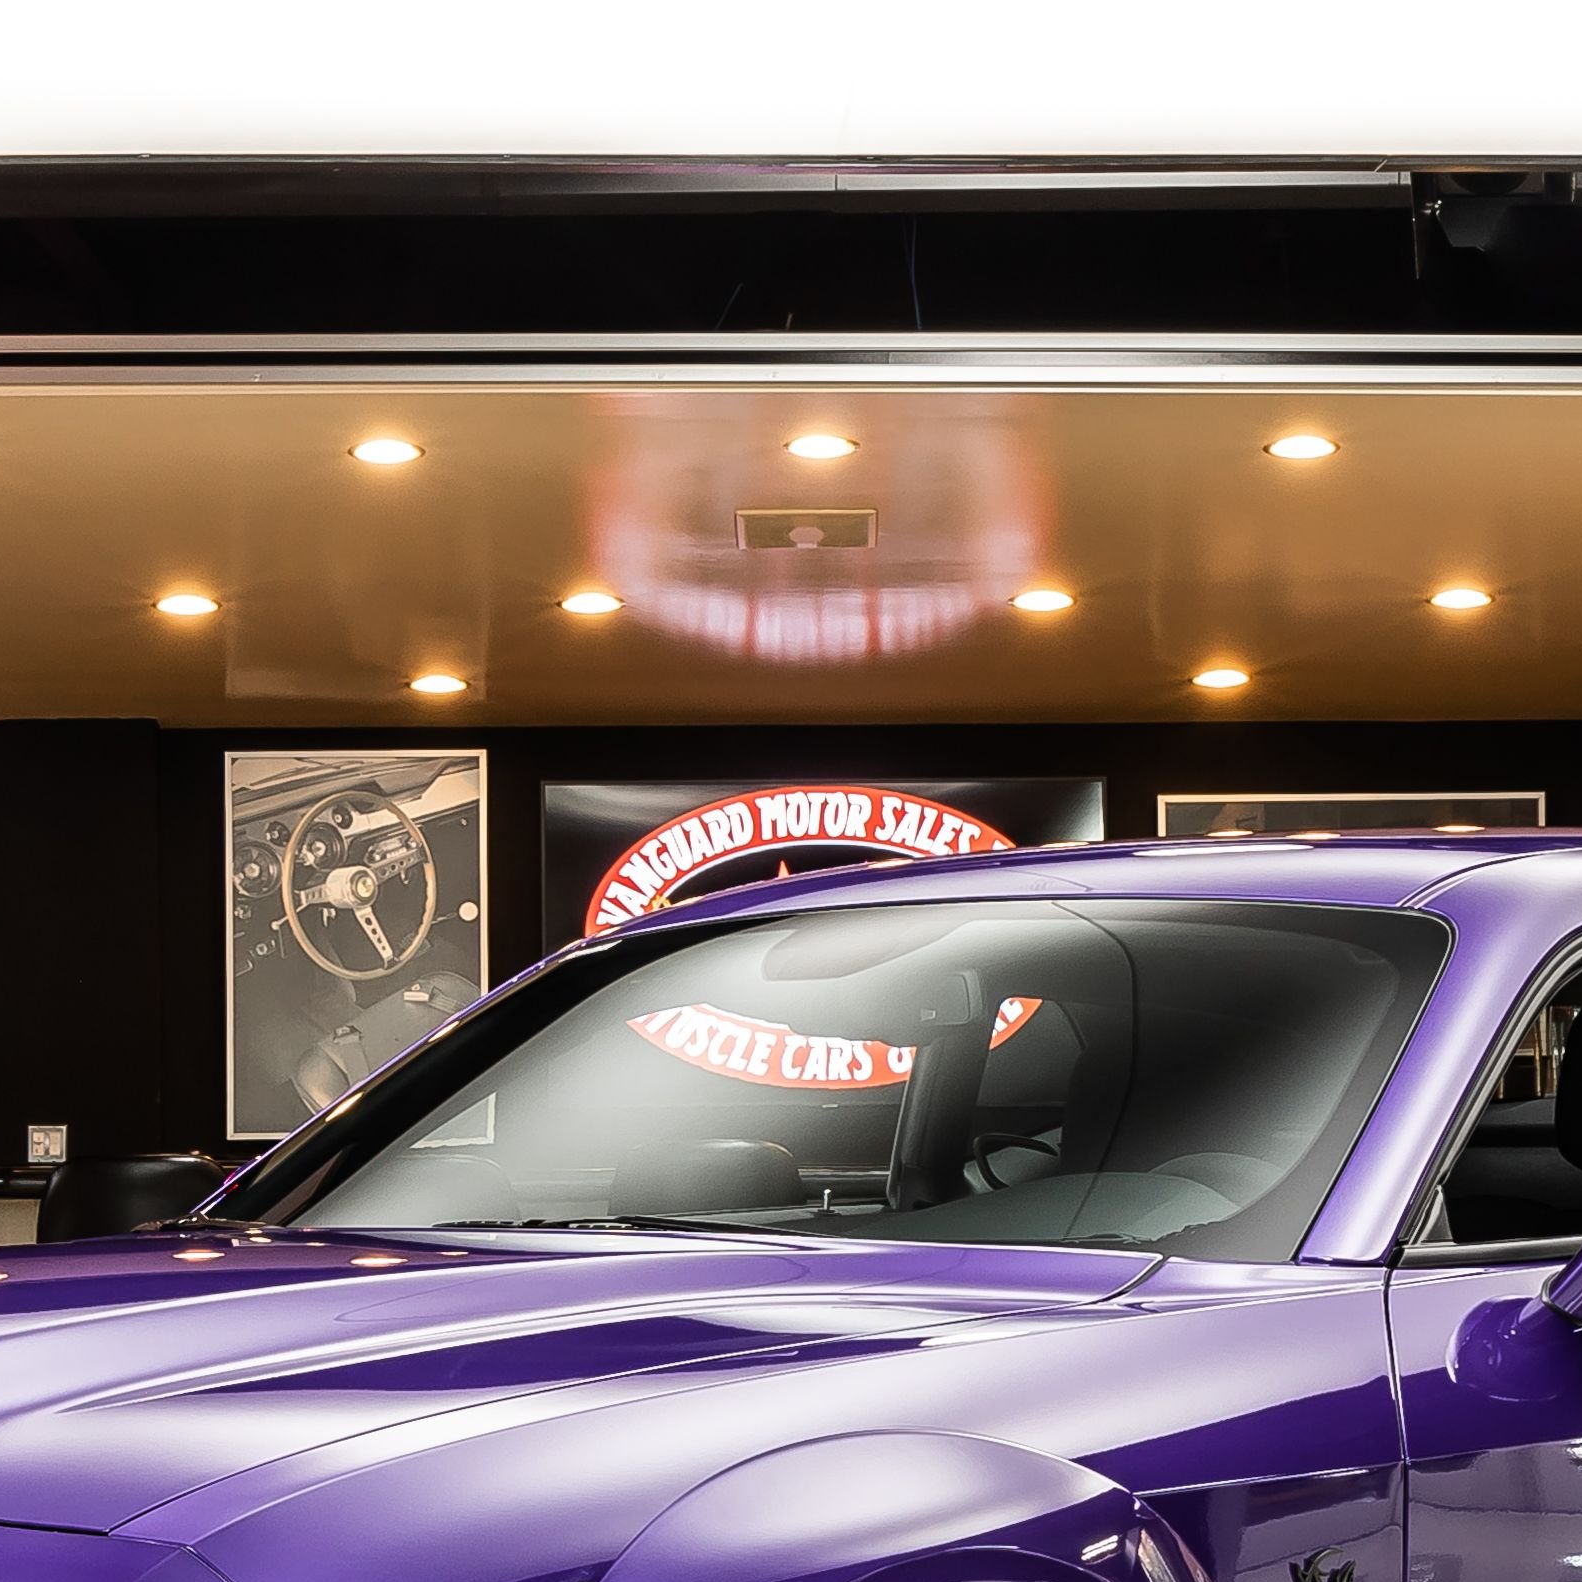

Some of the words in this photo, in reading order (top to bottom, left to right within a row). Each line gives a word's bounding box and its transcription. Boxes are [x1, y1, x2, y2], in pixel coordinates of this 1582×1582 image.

[595, 801, 754, 926] VANGUARD
[755, 791, 873, 841] MOTOR
[874, 796, 982, 856] SALES
[781, 1034, 874, 1082] CARS
